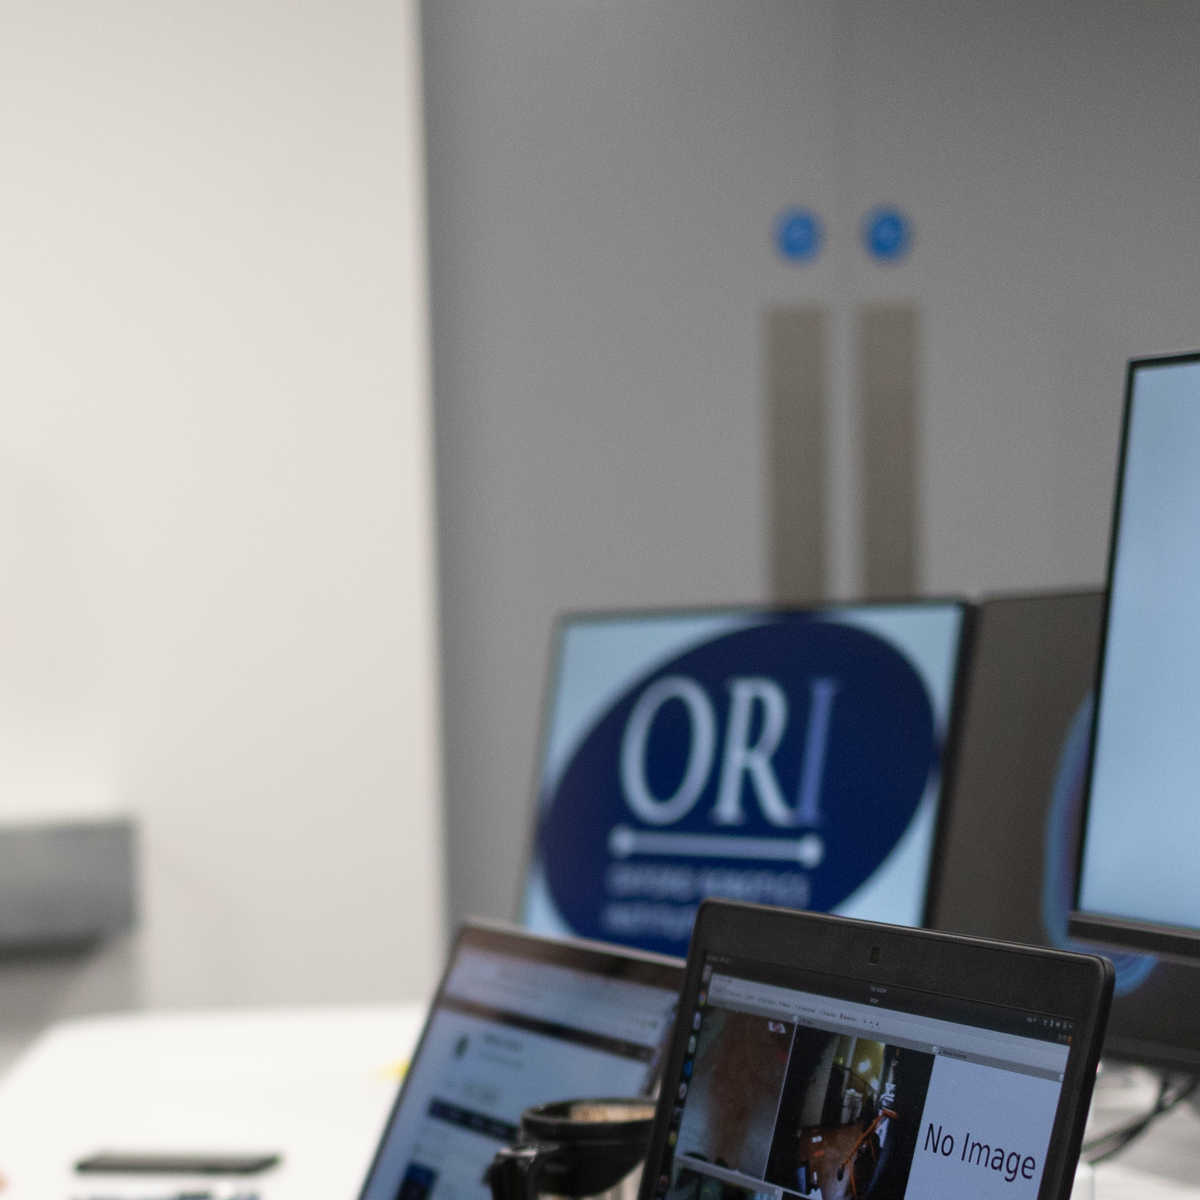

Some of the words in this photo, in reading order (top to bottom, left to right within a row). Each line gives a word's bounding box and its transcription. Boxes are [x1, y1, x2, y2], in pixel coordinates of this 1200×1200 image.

[620, 674, 836, 828] ORI
[924, 1123, 954, 1157] No
[961, 1132, 1036, 1183] Image
